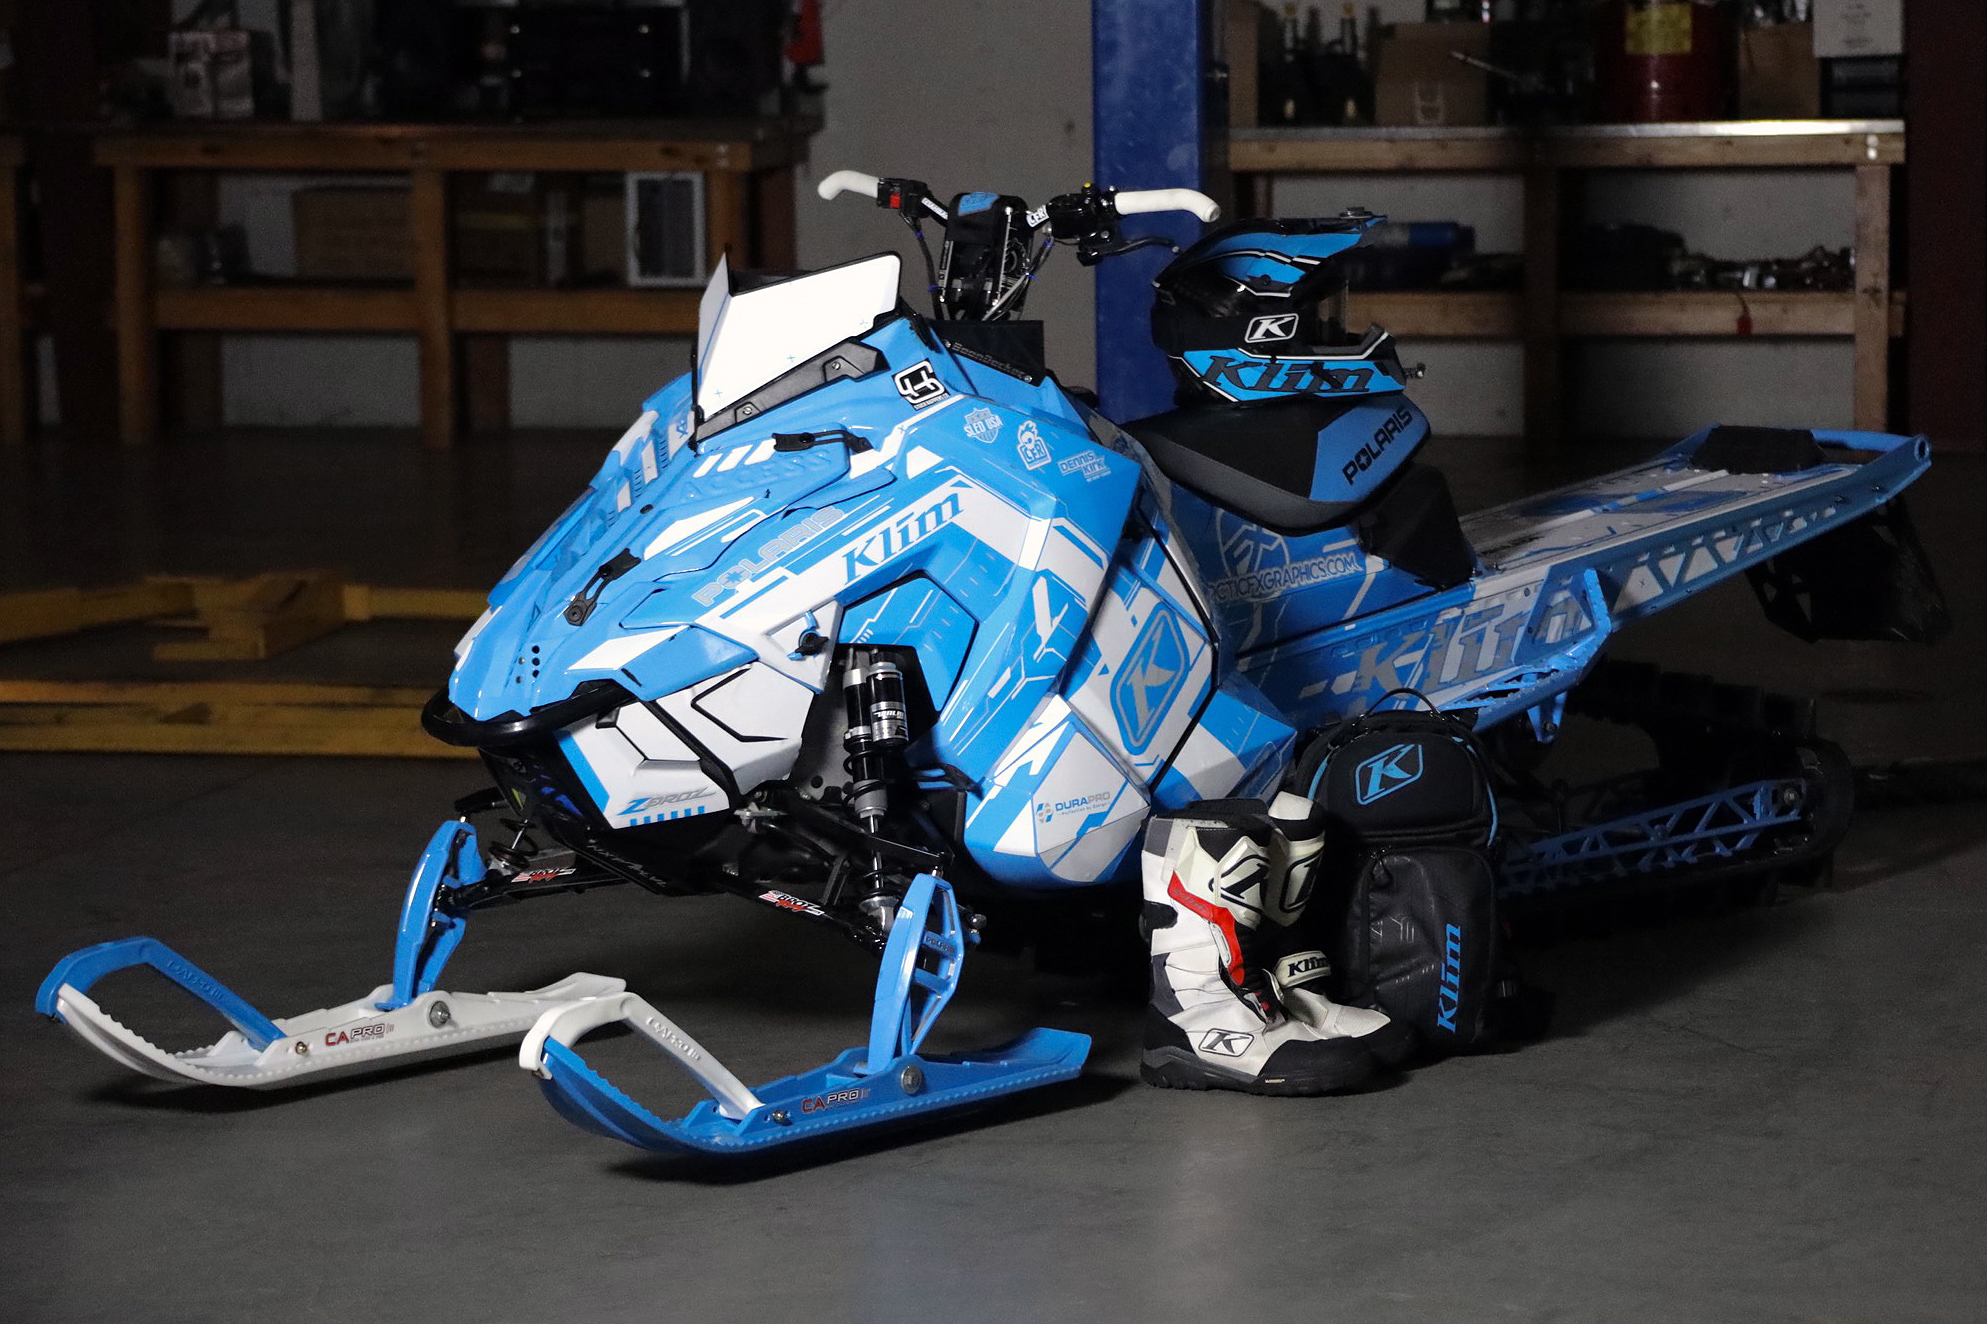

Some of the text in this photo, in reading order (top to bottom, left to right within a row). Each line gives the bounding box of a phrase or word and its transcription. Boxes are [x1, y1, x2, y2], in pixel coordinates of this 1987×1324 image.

[1248, 315, 1295, 340] K
[1203, 356, 1375, 394] Klim
[964, 415, 1004, 438] SLED USA
[1342, 405, 1413, 485] POLARIS
[842, 493, 964, 586] Klim
[691, 506, 848, 607] POLARIS
[1055, 791, 1111, 811] DURAPRO
[1436, 923, 1461, 1034] Klim
[350, 1023, 386, 1040] PRO
[827, 1089, 860, 1105] PRO
